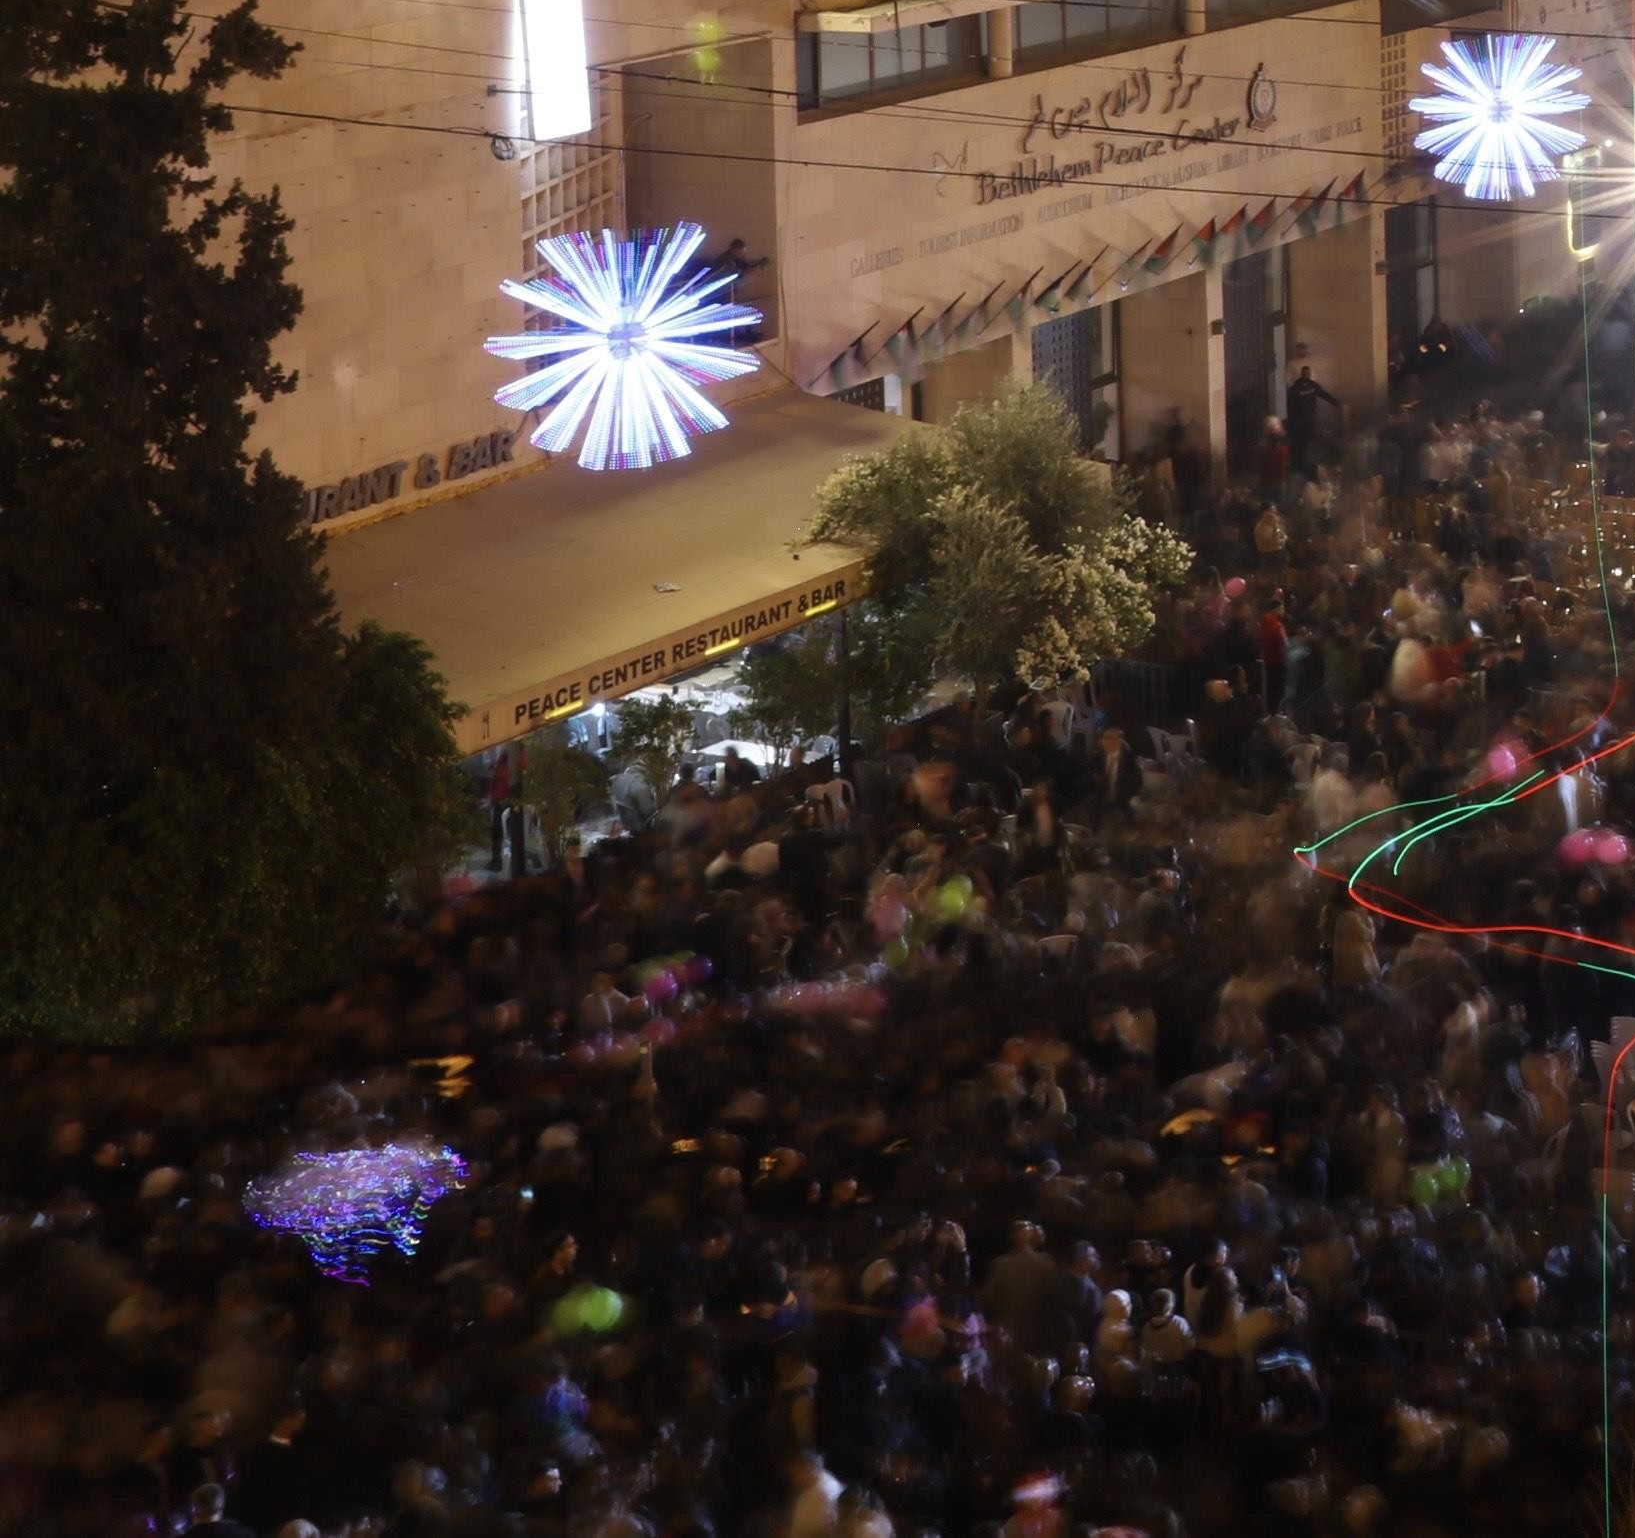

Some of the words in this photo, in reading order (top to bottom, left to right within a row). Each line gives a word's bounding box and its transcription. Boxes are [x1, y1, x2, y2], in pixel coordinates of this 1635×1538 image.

[1098, 66, 1151, 130] السلام
[1161, 45, 1205, 114] مركز
[976, 153, 1092, 205] Bethlehem
[1095, 139, 1167, 173] Peace
[1171, 117, 1240, 152] Center
[959, 212, 1024, 248] INFORMATION
[414, 453, 441, 489] &
[446, 428, 515, 480] BAR
[514, 681, 582, 725] PEACE
[588, 648, 666, 695] CENTER
[672, 599, 793, 662] RESTAURANT
